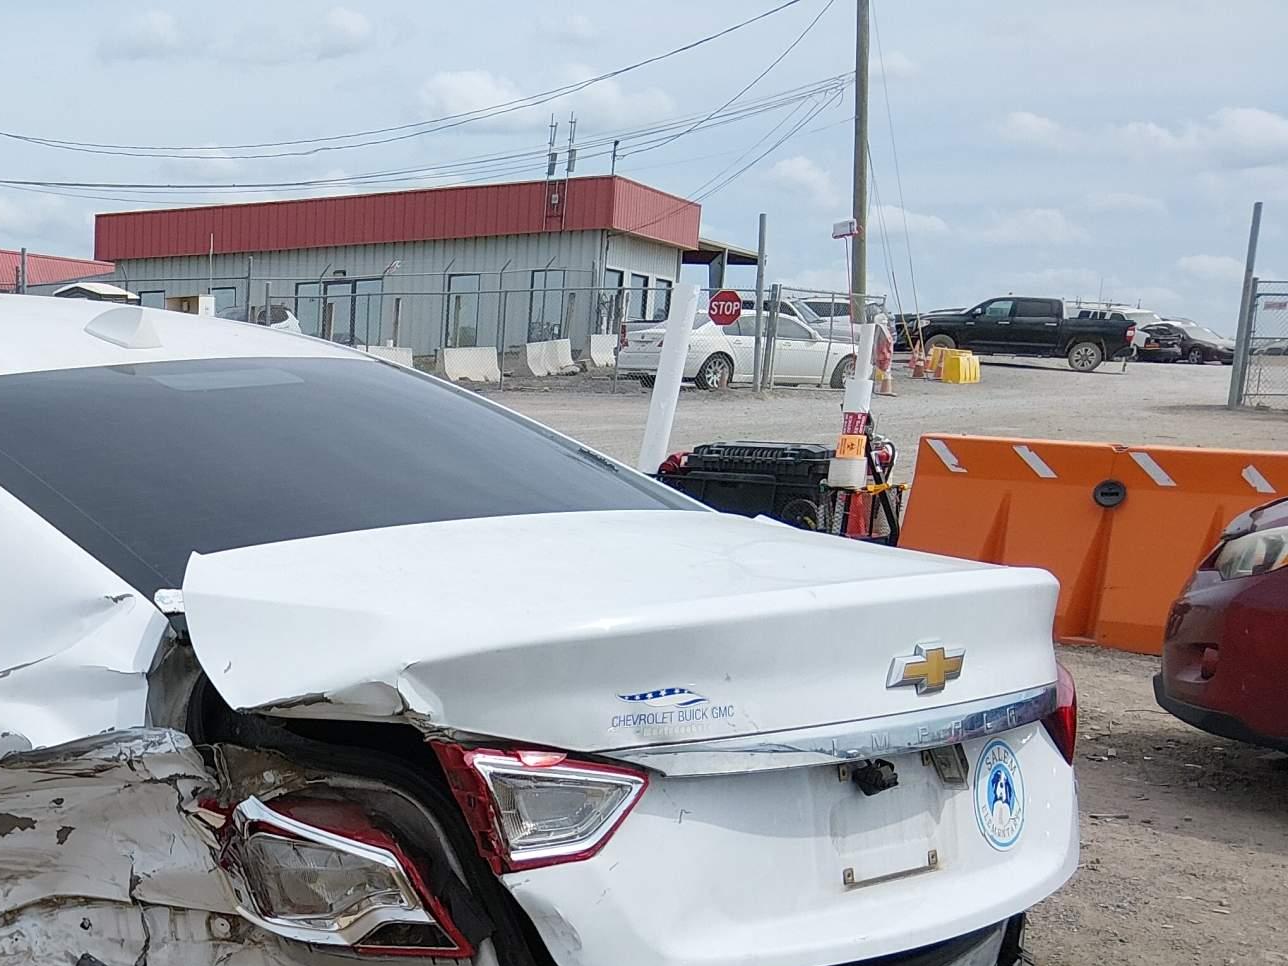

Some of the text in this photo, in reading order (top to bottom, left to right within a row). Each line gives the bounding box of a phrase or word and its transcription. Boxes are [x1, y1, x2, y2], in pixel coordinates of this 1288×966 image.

[710, 301, 740, 315] STOP
[611, 705, 735, 728] CHEVROLET BUICK GMC
[831, 707, 1019, 757] IMPALA
[985, 746, 1017, 775] SALEM
